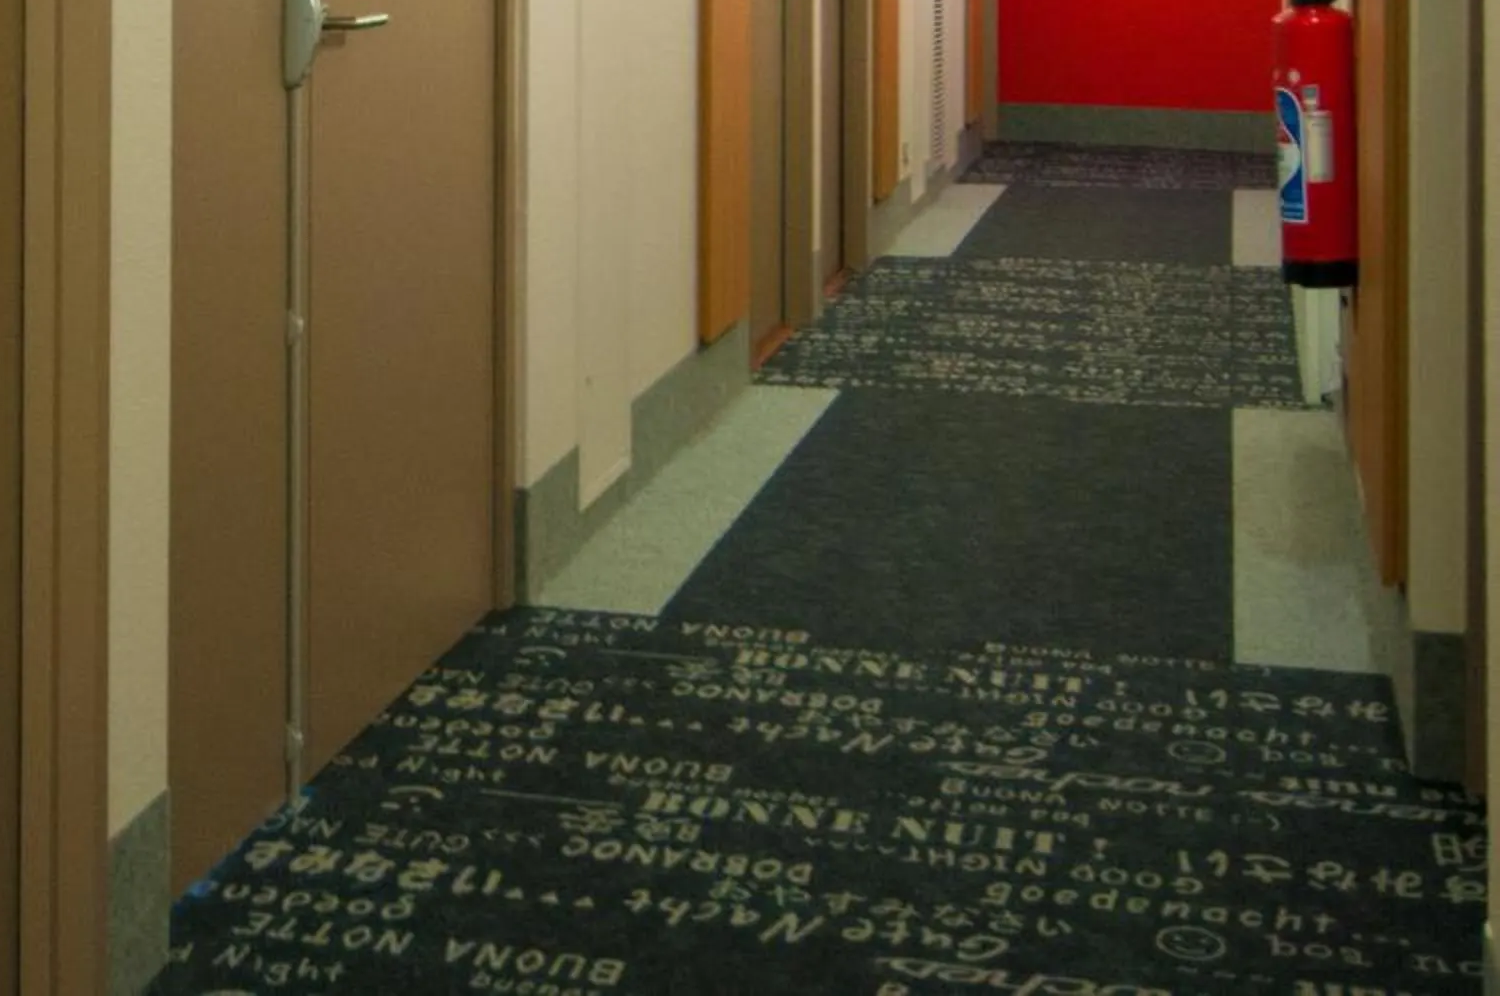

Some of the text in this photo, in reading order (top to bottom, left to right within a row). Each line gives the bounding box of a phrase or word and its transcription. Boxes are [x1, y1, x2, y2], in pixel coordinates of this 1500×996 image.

[407, 733, 733, 783] BUONA NOTTE
[641, 791, 871, 835] BONNE
[891, 815, 1067, 855] NUIT
[560, 834, 813, 886] DOBRANOC
[900, 847, 1204, 895] GOOD NIGHT
[232, 911, 626, 986] BUONA NOTTE
[623, 887, 1011, 962] Gute Nacht
[211, 942, 344, 986] Night
